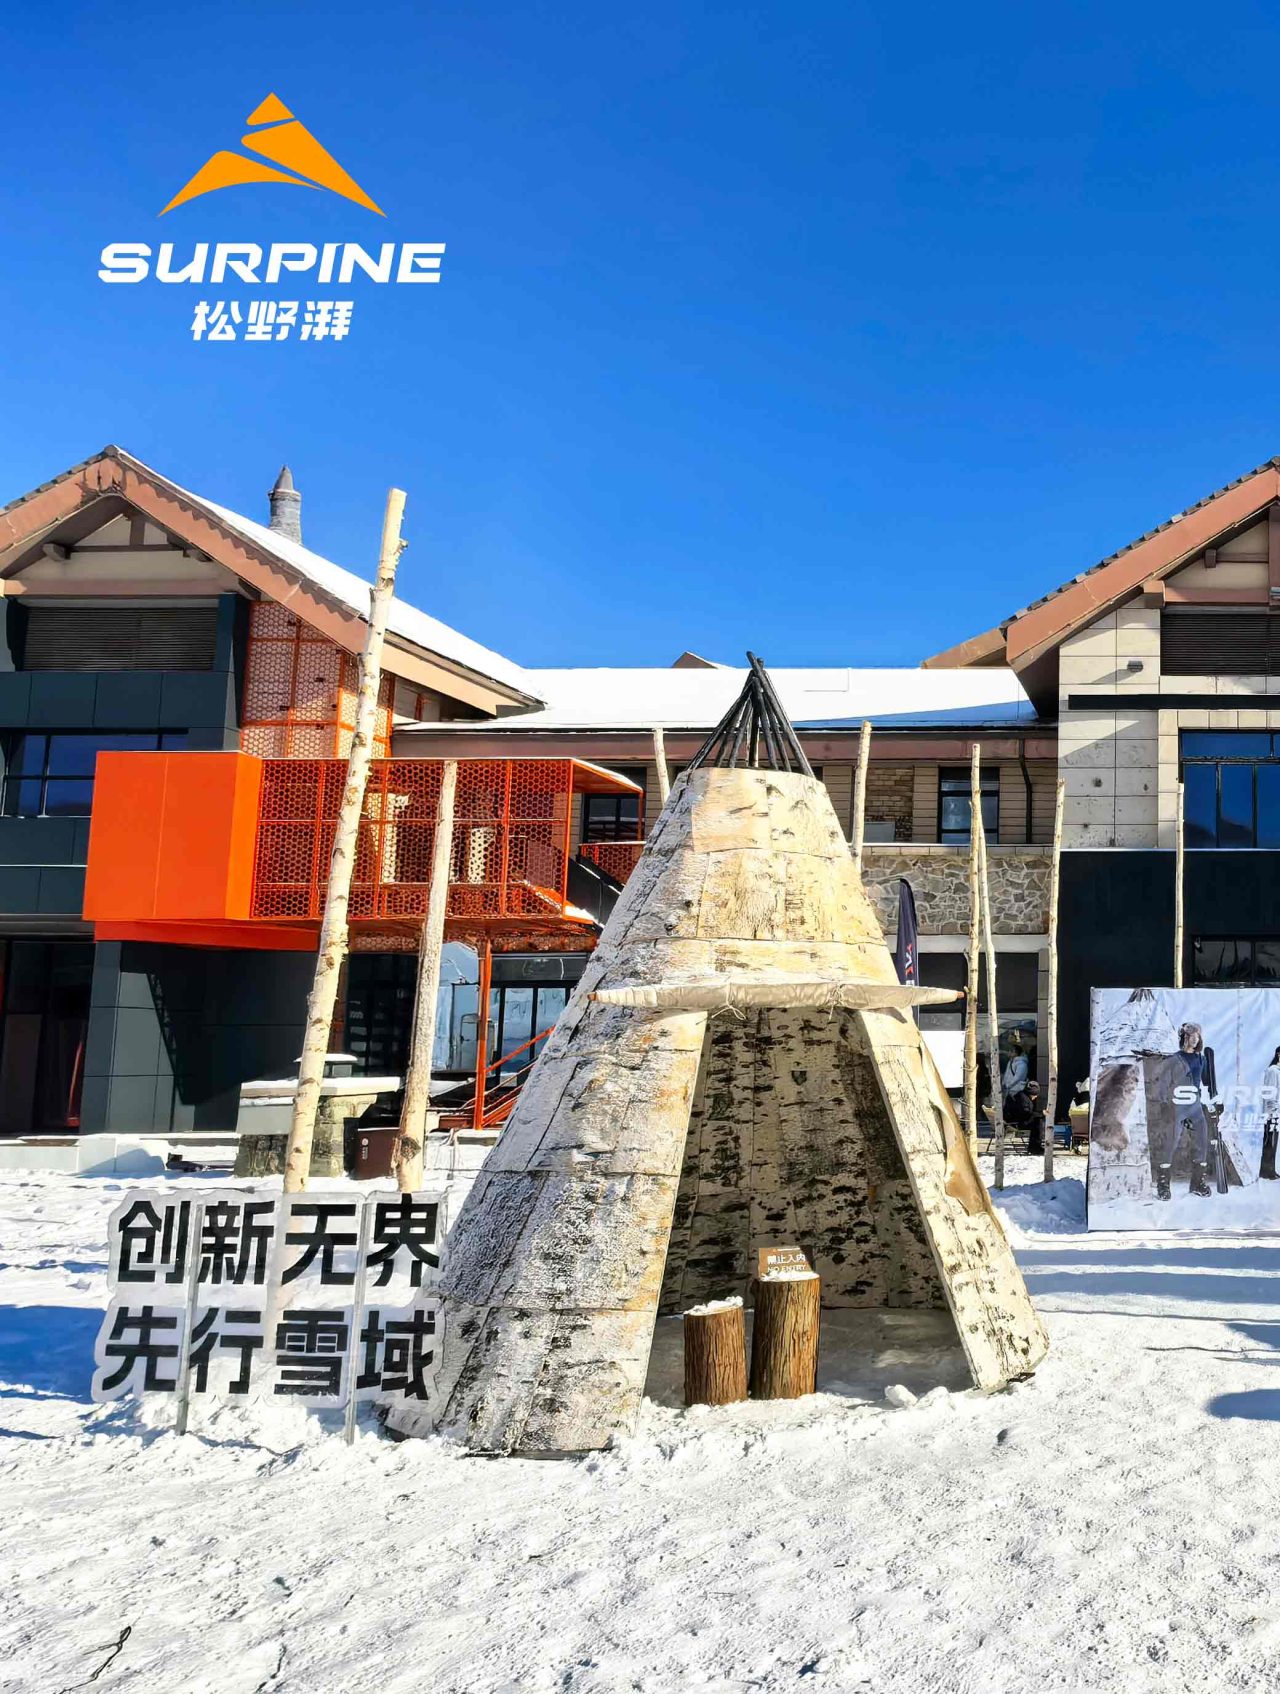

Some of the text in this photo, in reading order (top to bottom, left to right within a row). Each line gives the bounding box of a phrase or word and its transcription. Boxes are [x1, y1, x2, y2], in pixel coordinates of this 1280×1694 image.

[118, 1193, 440, 1287] 创新无界
[102, 1305, 436, 1400] 先行雪域
